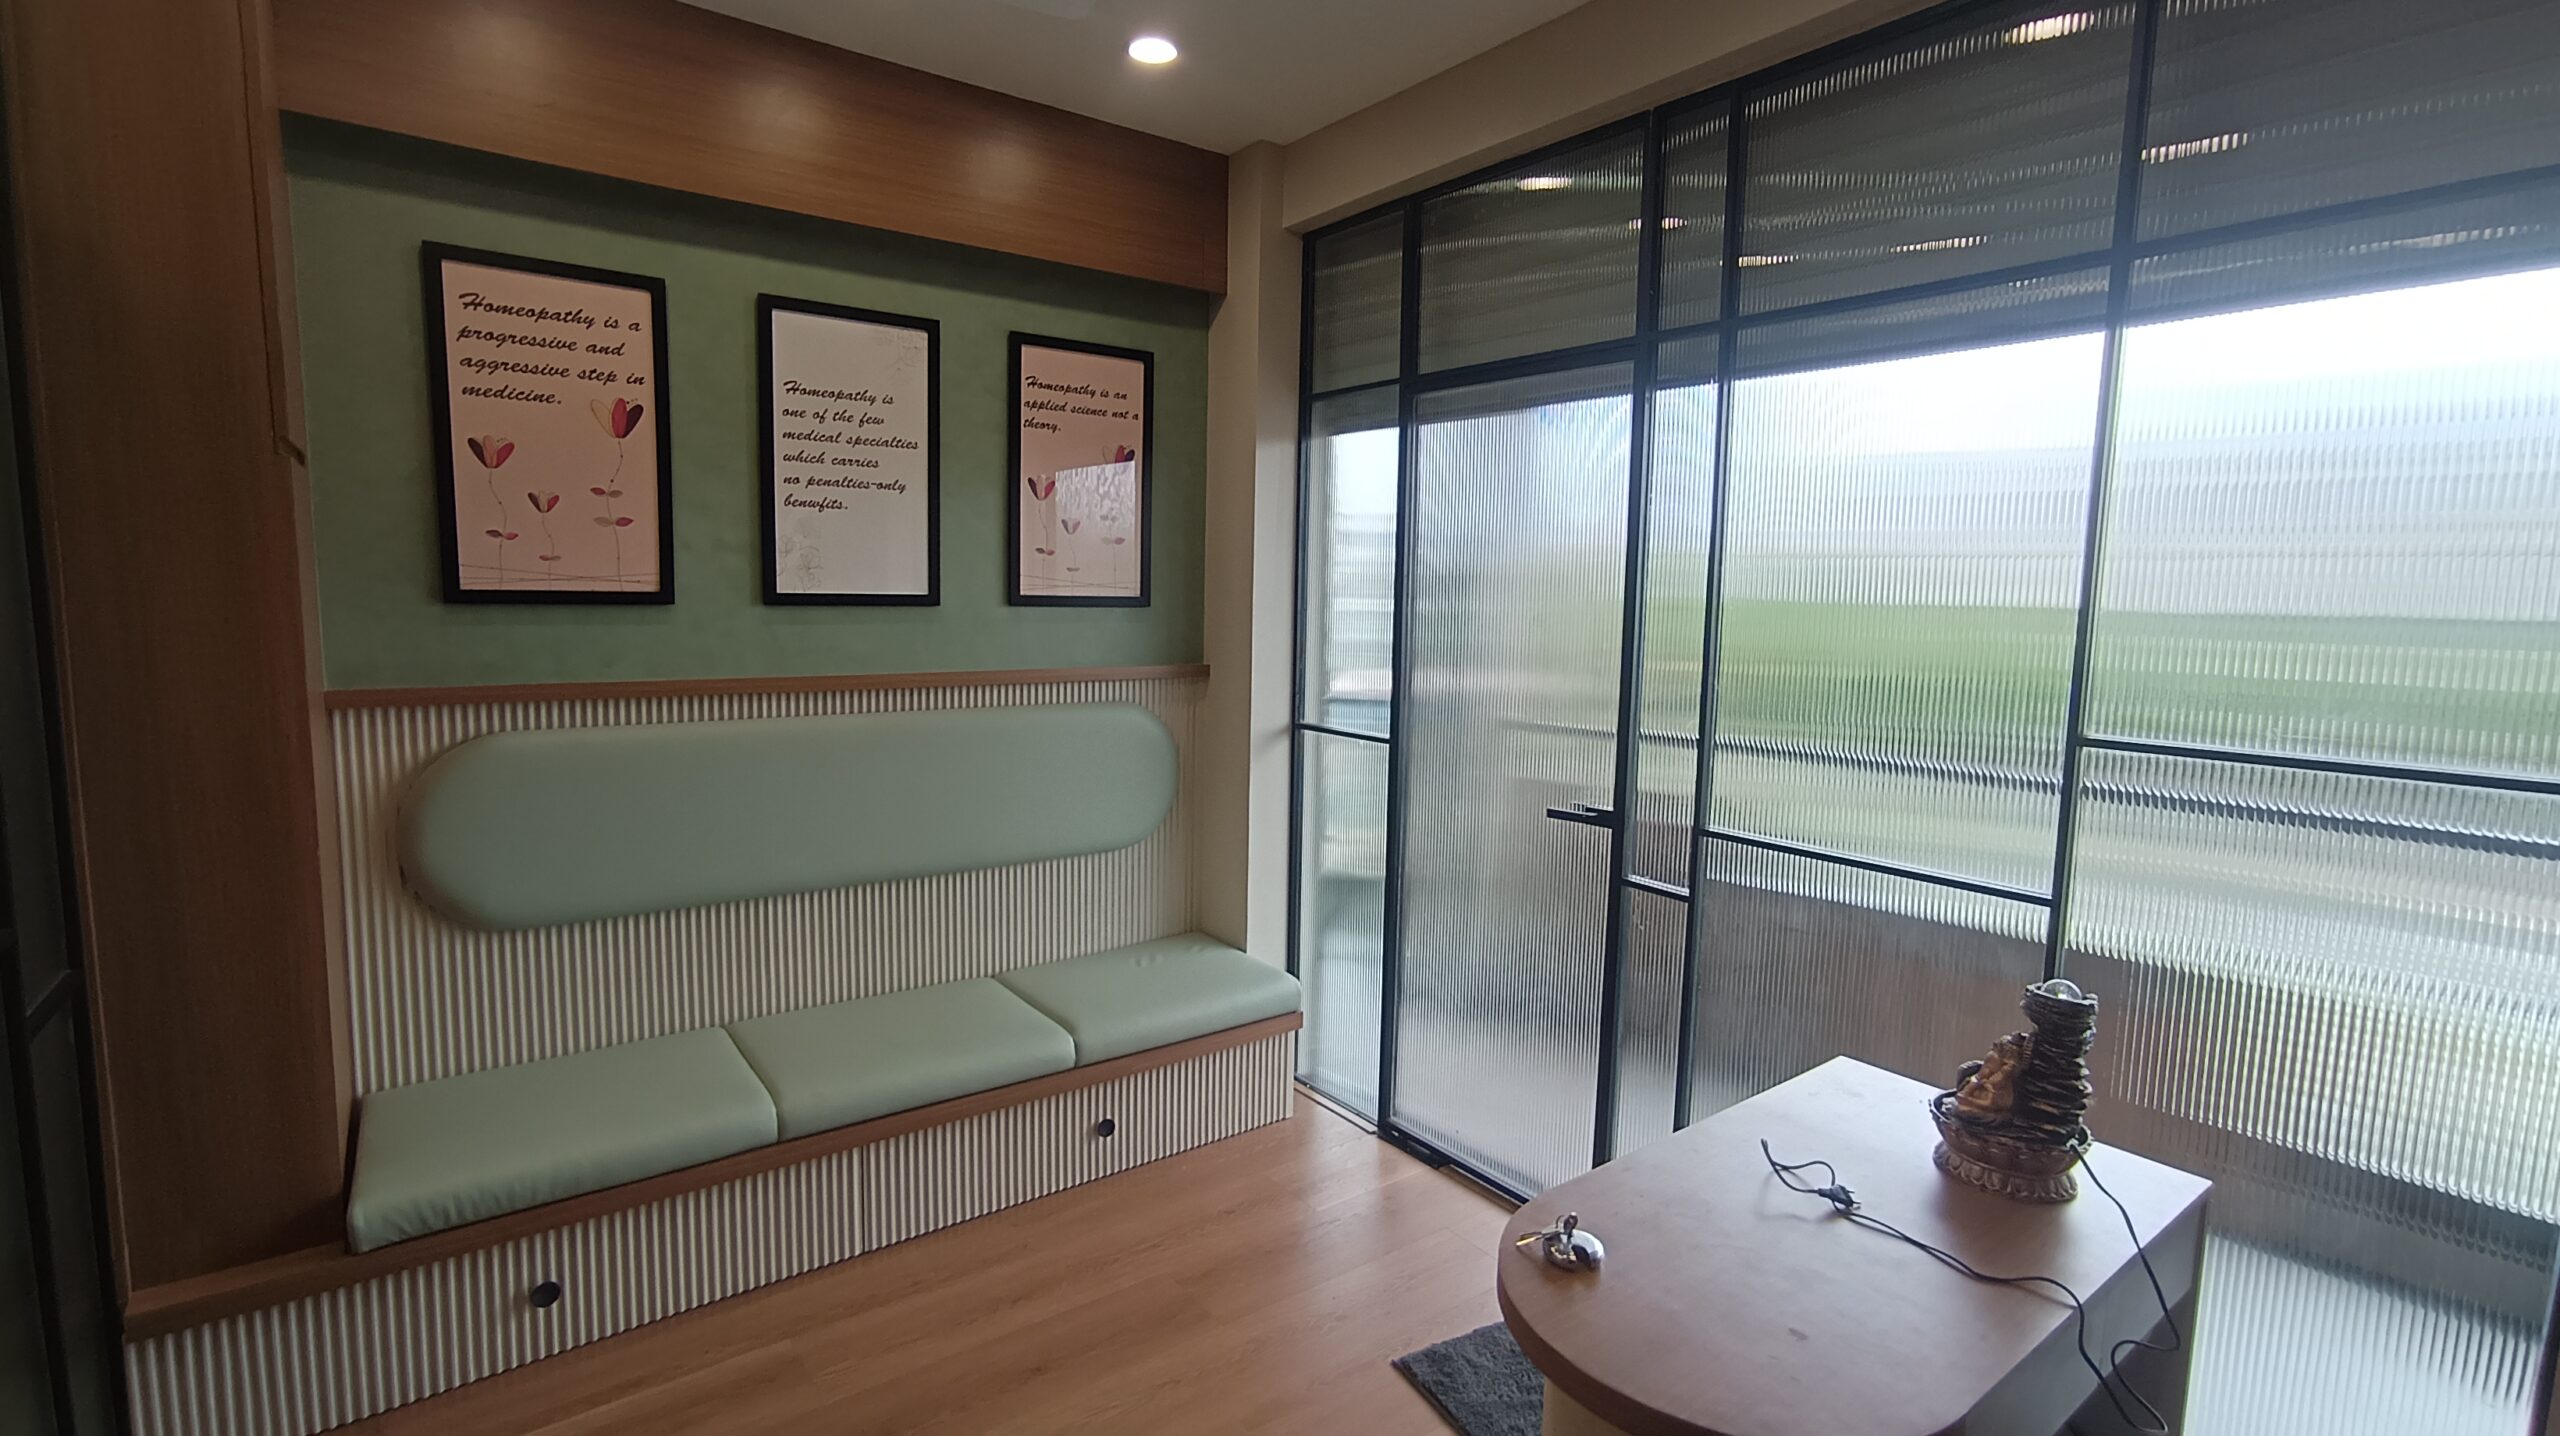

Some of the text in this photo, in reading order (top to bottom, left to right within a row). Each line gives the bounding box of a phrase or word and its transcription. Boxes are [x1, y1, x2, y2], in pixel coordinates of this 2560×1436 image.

[459, 293, 642, 332] Homeopathy is a
[456, 326, 625, 356] progressive and
[460, 357, 646, 385] aggressive step in
[462, 385, 562, 404] medicine.
[783, 380, 894, 406] Homeopathy is
[1025, 376, 1127, 400] Homeopathy is an
[782, 408, 884, 428] one of the few
[1024, 400, 1068, 412] applied
[1070, 405, 1107, 417] science
[1112, 411, 1129, 419] not
[1023, 417, 1061, 433] theory.
[783, 430, 919, 449] medical specialties
[783, 450, 880, 468] which carries
[783, 475, 906, 494] no penalties-only
